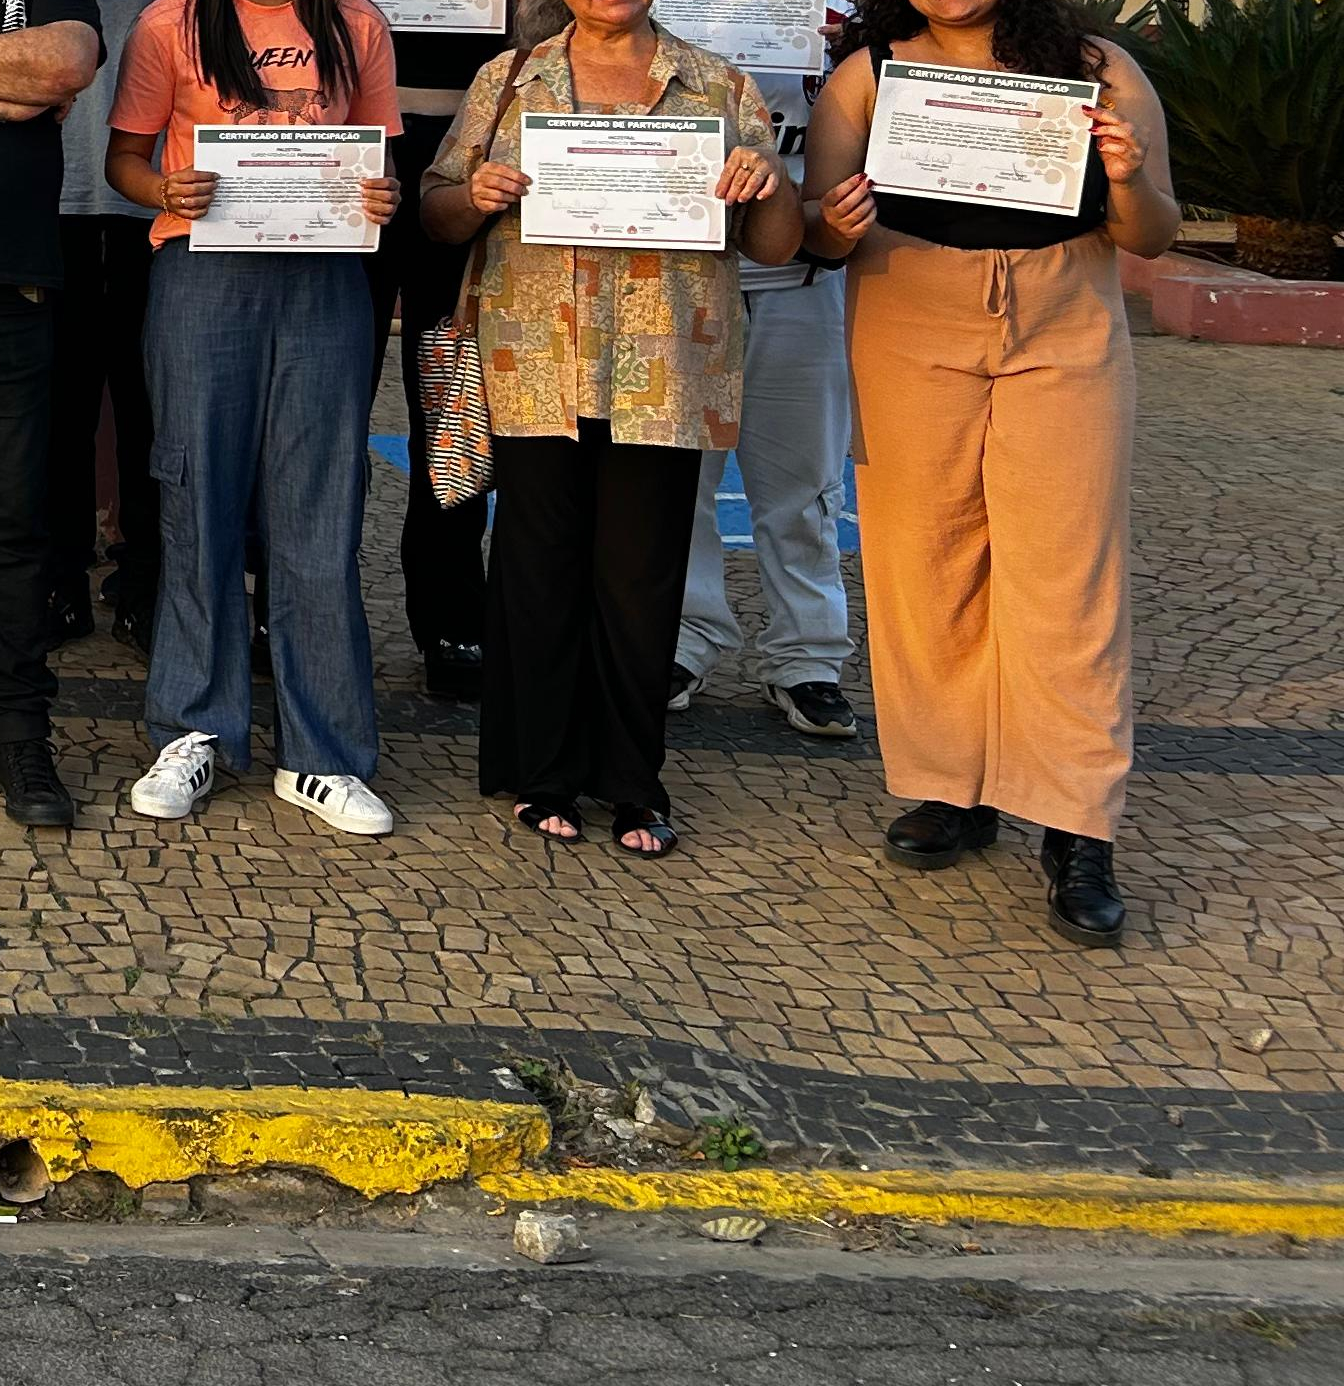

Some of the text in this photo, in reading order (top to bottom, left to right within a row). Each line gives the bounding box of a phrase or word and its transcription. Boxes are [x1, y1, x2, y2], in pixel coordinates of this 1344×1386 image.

[250, 47, 313, 70] UEEN
[908, 69, 1069, 93] CERTIFICADO DE PARTICIPAÇÃO
[547, 119, 697, 131] CERTIFICADO DE PARTICIPAÇÃO
[219, 132, 278, 140] CERTIFICADO
[295, 132, 360, 141] PARTICIPAÇÃO
